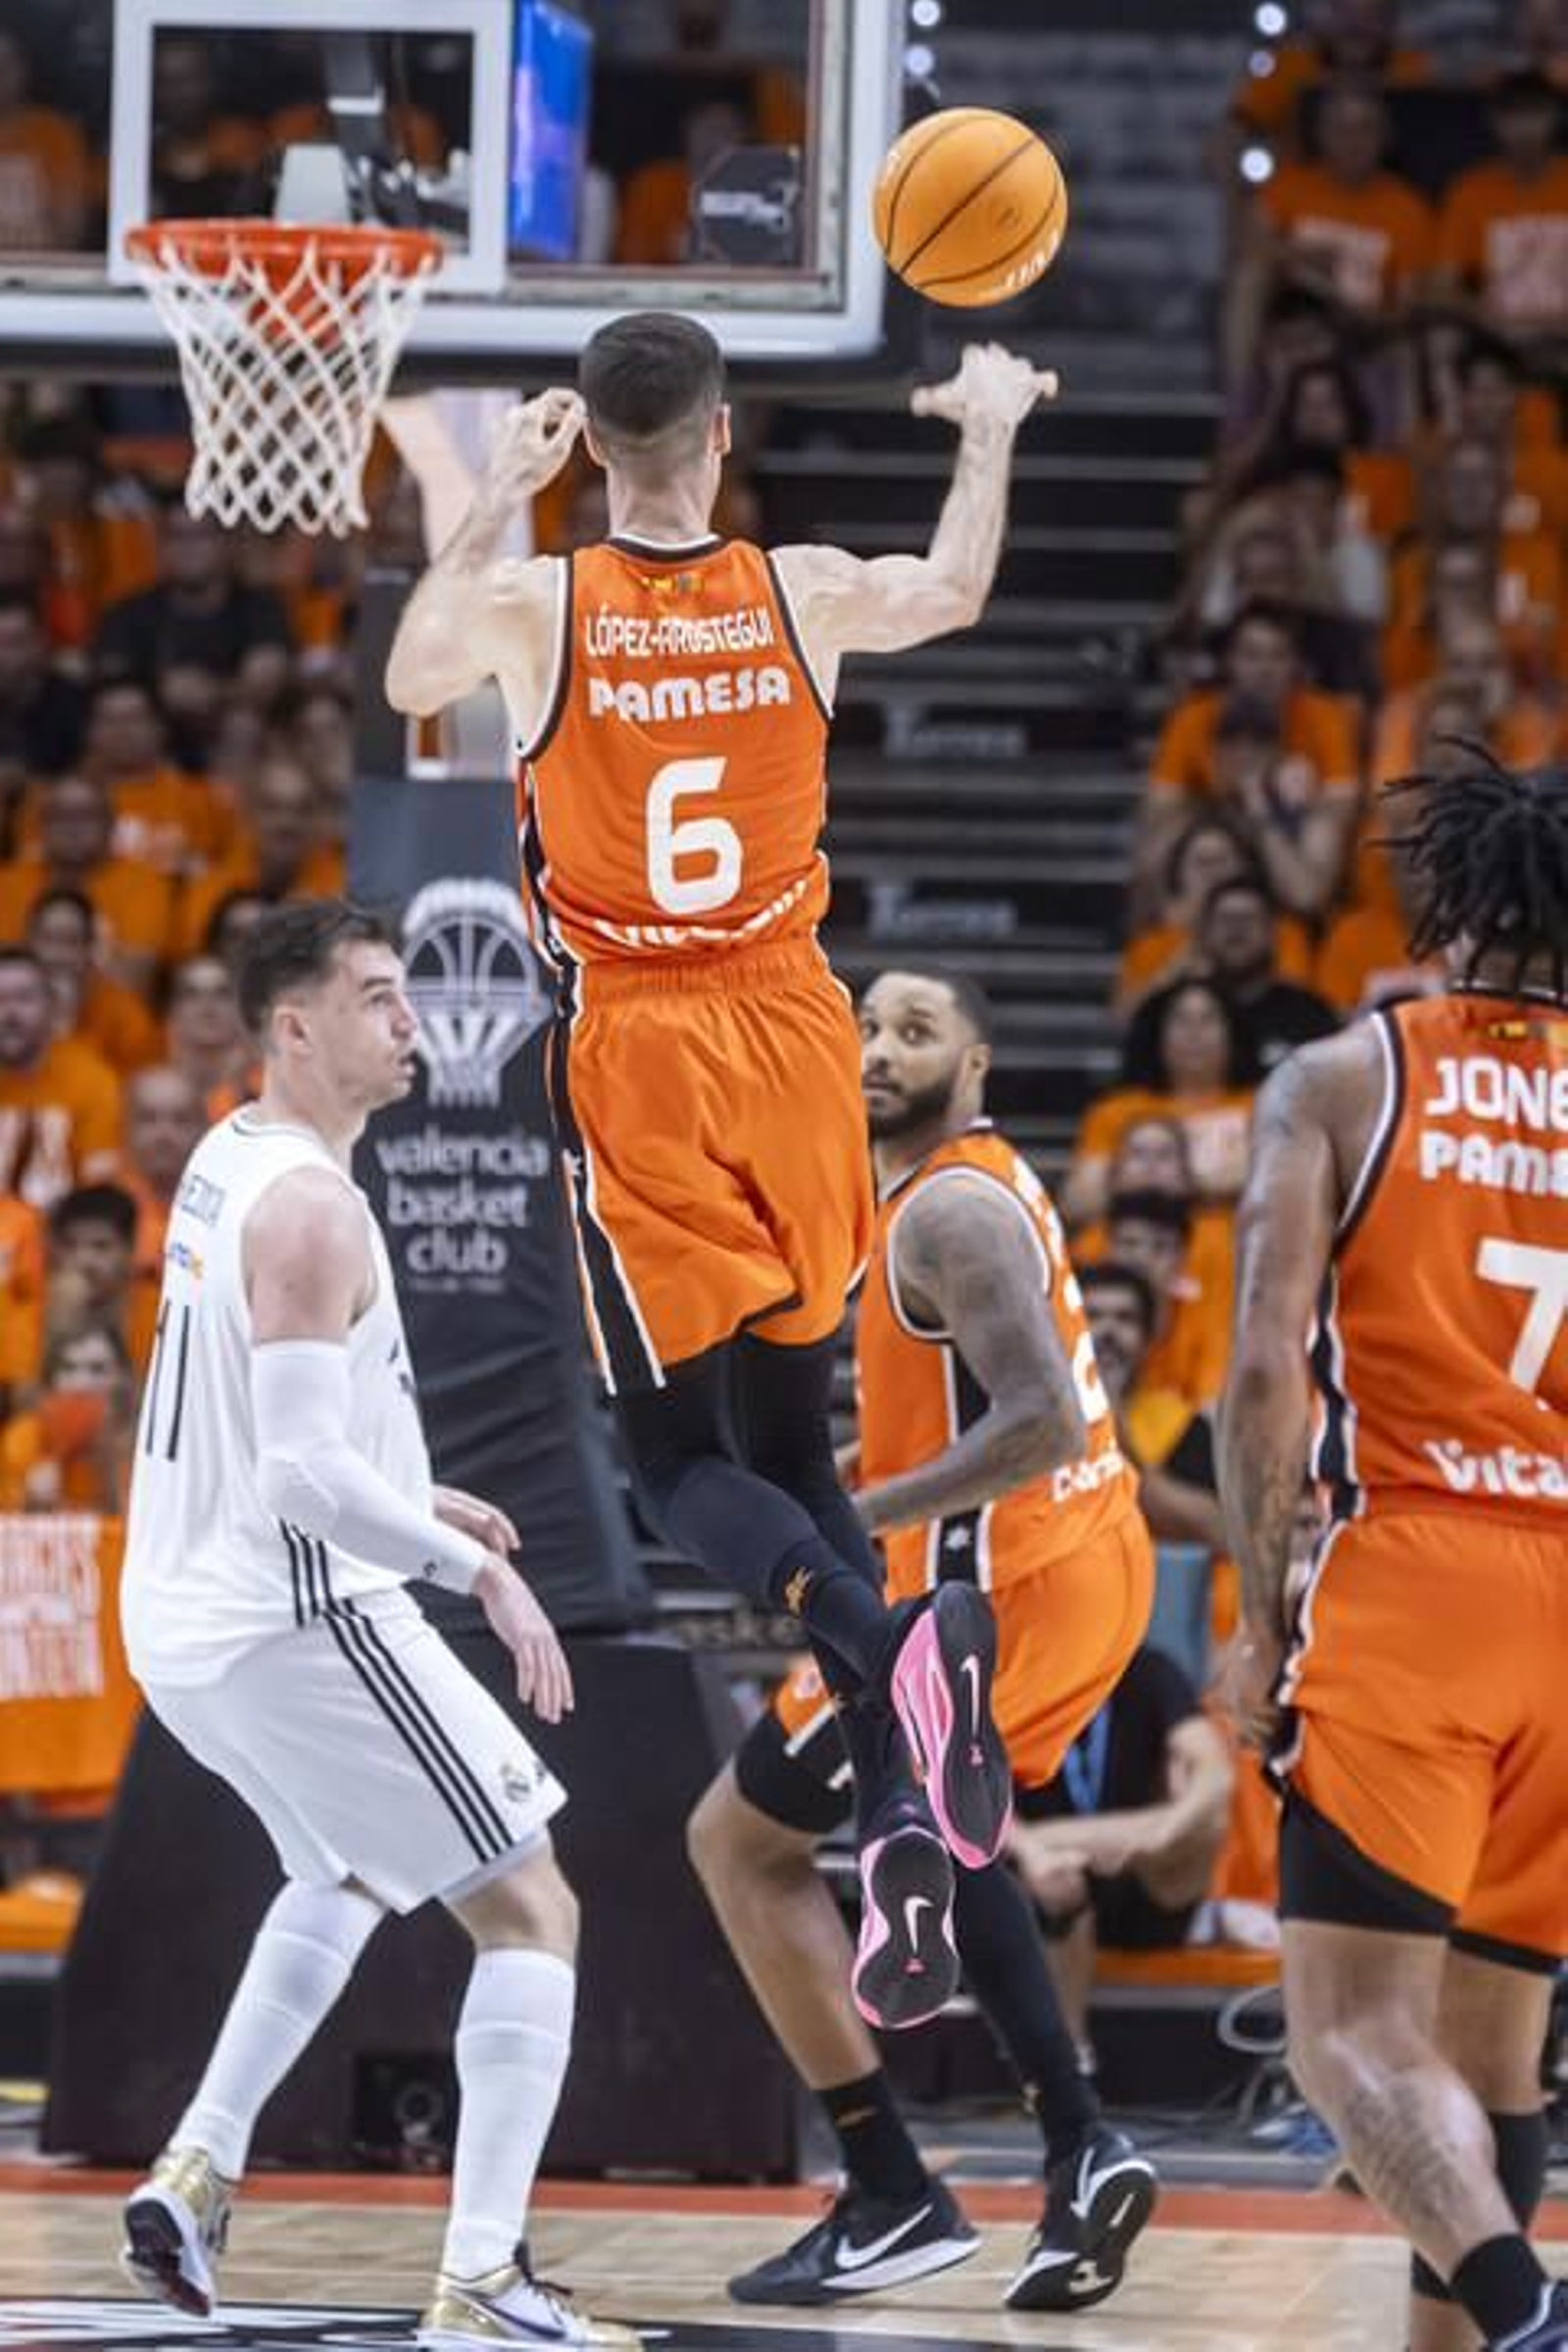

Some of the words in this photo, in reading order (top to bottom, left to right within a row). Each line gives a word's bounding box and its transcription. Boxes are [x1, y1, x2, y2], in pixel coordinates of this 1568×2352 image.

[588, 665, 792, 722] PAMESA
[646, 756, 743, 915] 6
[374, 1123, 551, 1176] valencia
[387, 1177, 529, 1228] basket
[406, 1224, 509, 1273] club
[1475, 1236, 1568, 1411] 7
